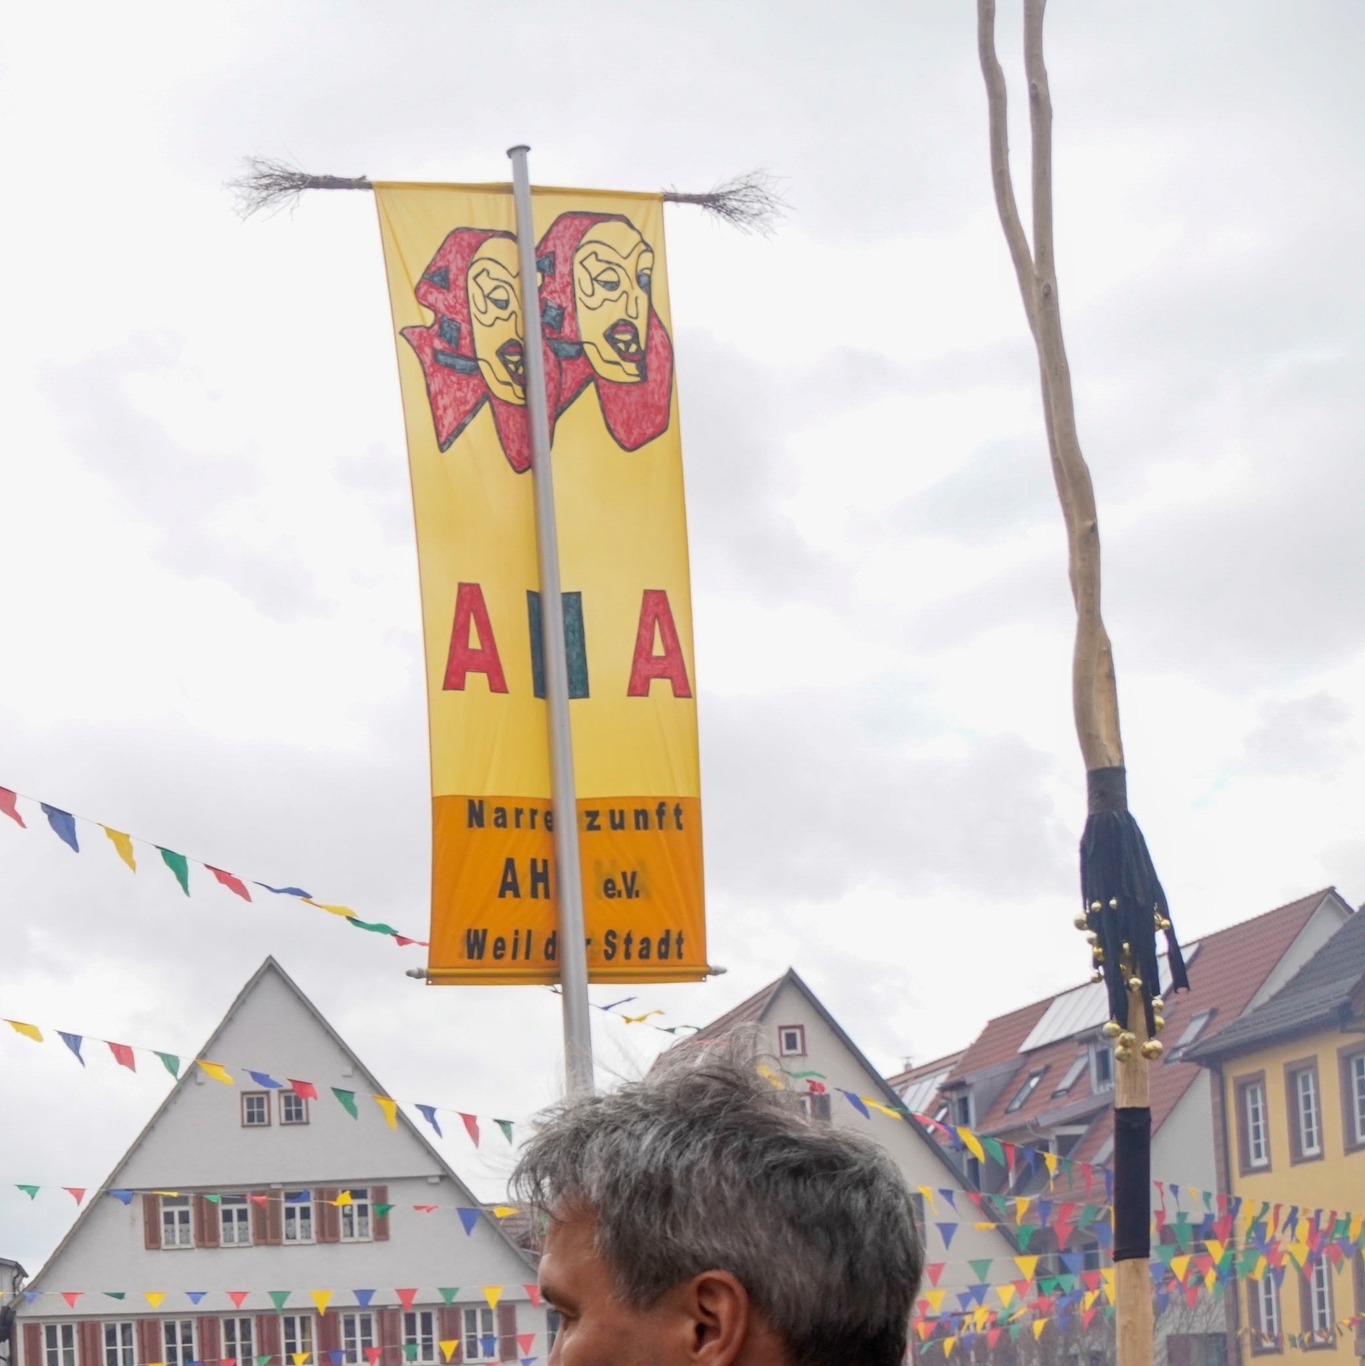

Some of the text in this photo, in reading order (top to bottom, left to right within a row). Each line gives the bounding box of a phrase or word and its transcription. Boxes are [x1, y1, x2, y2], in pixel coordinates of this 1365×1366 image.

[467, 799, 684, 831] Narrezunft
[498, 857, 640, 900] AH e.V.
[466, 928, 684, 961] Weil dr Stadt
